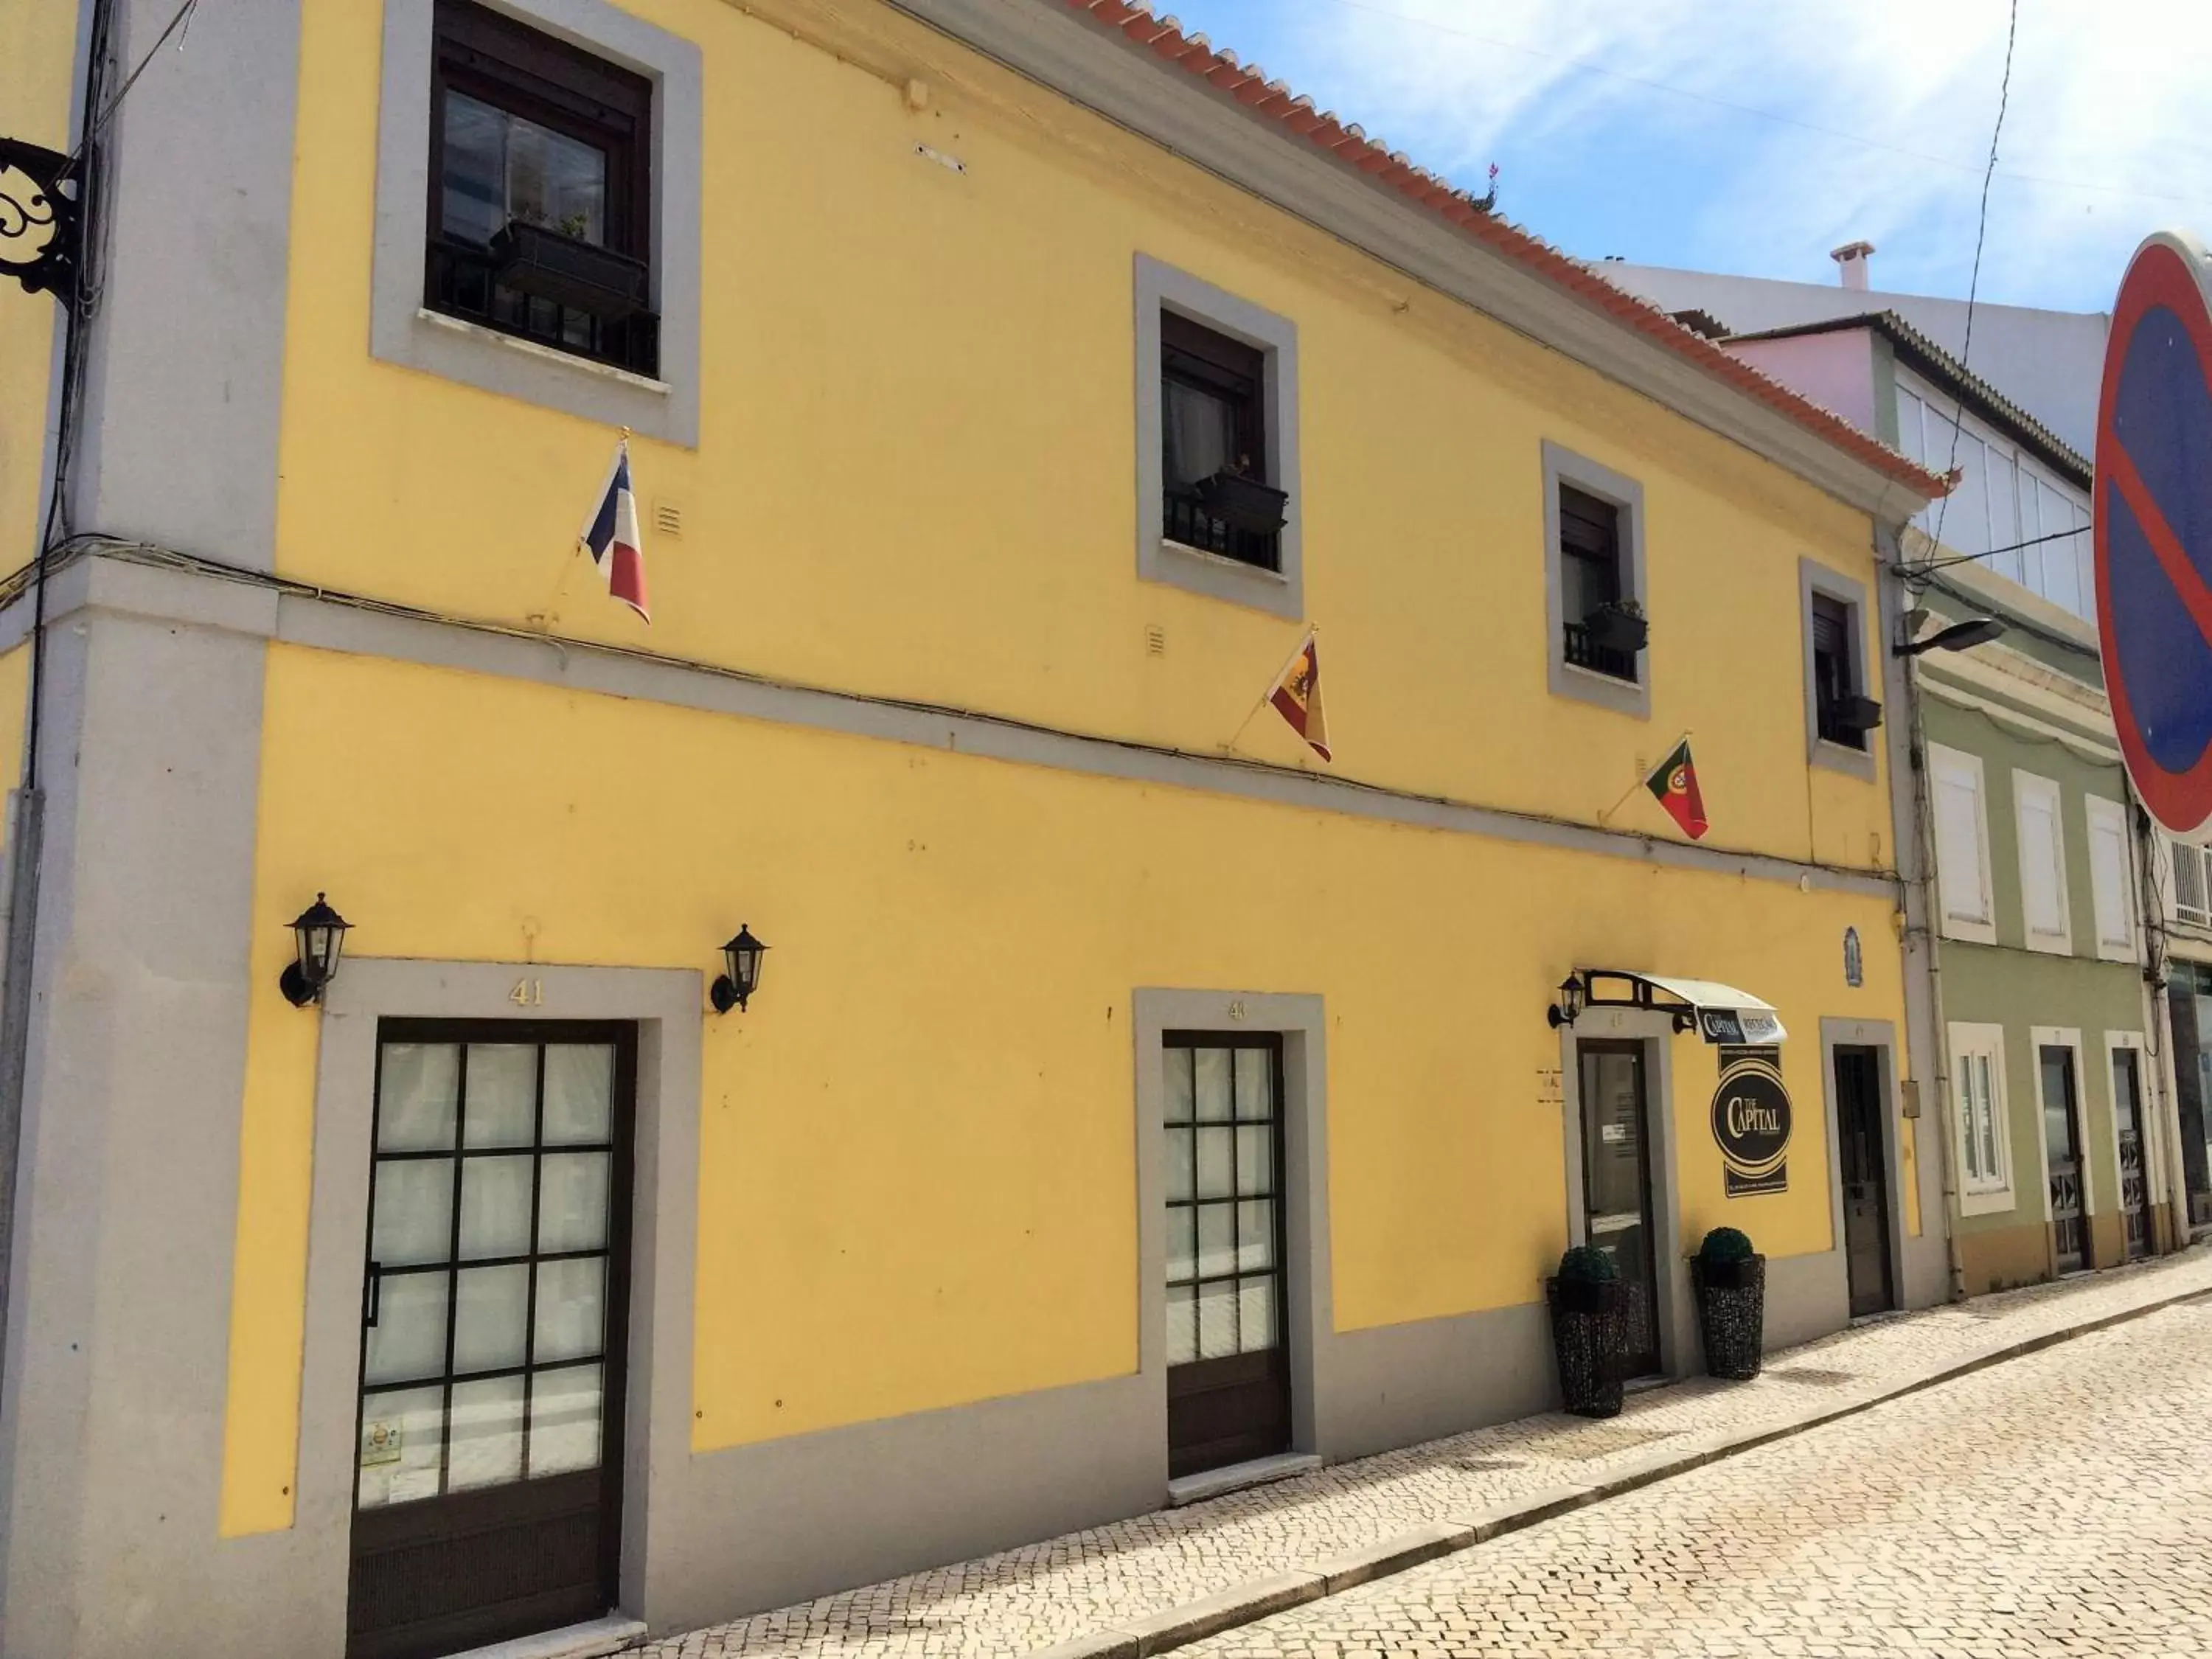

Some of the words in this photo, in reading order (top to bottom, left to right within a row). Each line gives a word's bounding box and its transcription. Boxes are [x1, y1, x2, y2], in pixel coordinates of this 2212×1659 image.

[508, 976, 543, 1006] 41
[1704, 1013, 1739, 1037] CAPITAL
[1743, 1098, 1757, 1108] THE
[1728, 1096, 1781, 1138] CAPITAL
